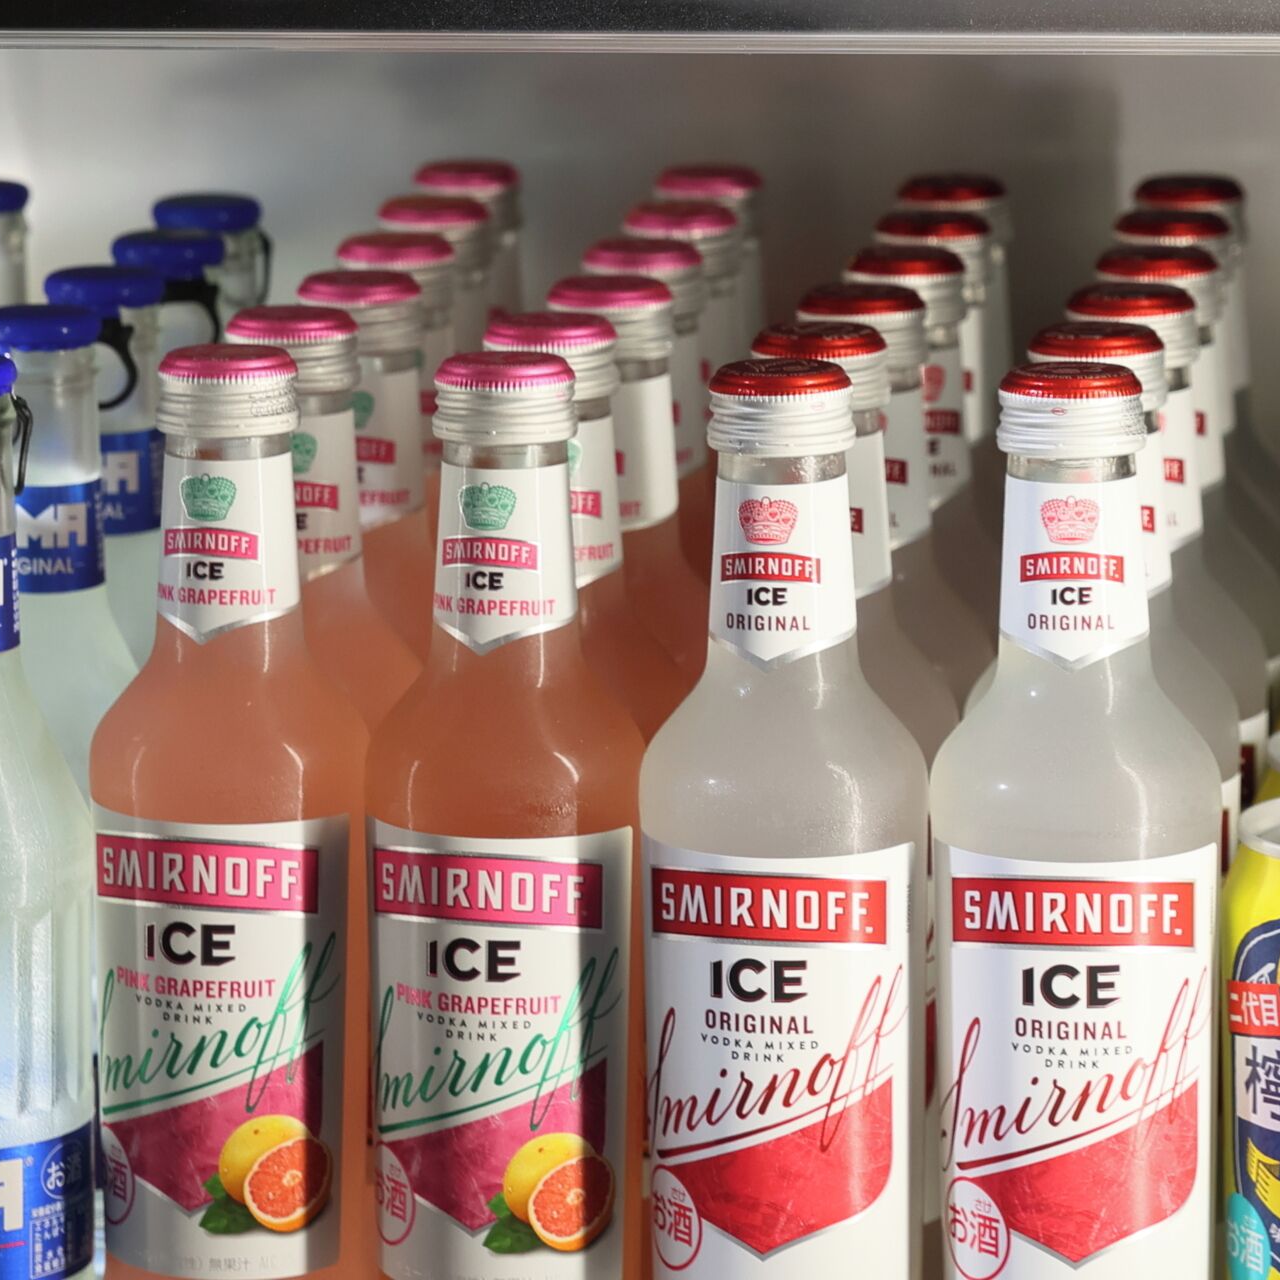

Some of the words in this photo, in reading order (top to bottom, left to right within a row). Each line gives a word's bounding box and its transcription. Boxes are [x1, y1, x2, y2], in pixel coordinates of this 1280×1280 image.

[186, 561, 225, 580] ICE
[464, 571, 504, 591] ICE
[178, 587, 276, 606] GRAPEFRUIT
[746, 587, 788, 606] ICE
[1051, 586, 1093, 606] ICE
[456, 598, 556, 617] GRAPEFRUIT
[726, 612, 811, 632] ORIGINAL
[1027, 613, 1116, 631] ORIGINAL
[102, 846, 302, 901] SMIRNOFF
[382, 861, 587, 916] SMIRNOFF
[144, 921, 236, 967] ICE
[426, 937, 522, 983] ICE
[116, 965, 151, 992] PINK
[155, 975, 277, 1000] GRAPEFRUIT
[709, 957, 808, 1003] ICE
[1021, 963, 1122, 1009] ICE
[135, 993, 185, 1014] VODKA
[194, 1002, 248, 1014] MIXED
[396, 982, 433, 1010] PINK
[437, 992, 562, 1017] GRAPEFRUIT
[162, 1012, 214, 1026] DRINK
[417, 1010, 469, 1030] VODKA
[478, 1019, 533, 1031] MIXED
[705, 1008, 815, 1035] ORIGINAL
[1014, 1016, 1128, 1041] ORIGINAL
[446, 1029, 499, 1043] DRINK
[700, 1033, 755, 1050] VODKA
[764, 1039, 820, 1051] MIXED
[731, 1050, 786, 1064] DRINK
[1011, 1042, 1069, 1058] VODKA
[1080, 1045, 1135, 1057] MIXED
[1044, 1058, 1101, 1070] DRINK
